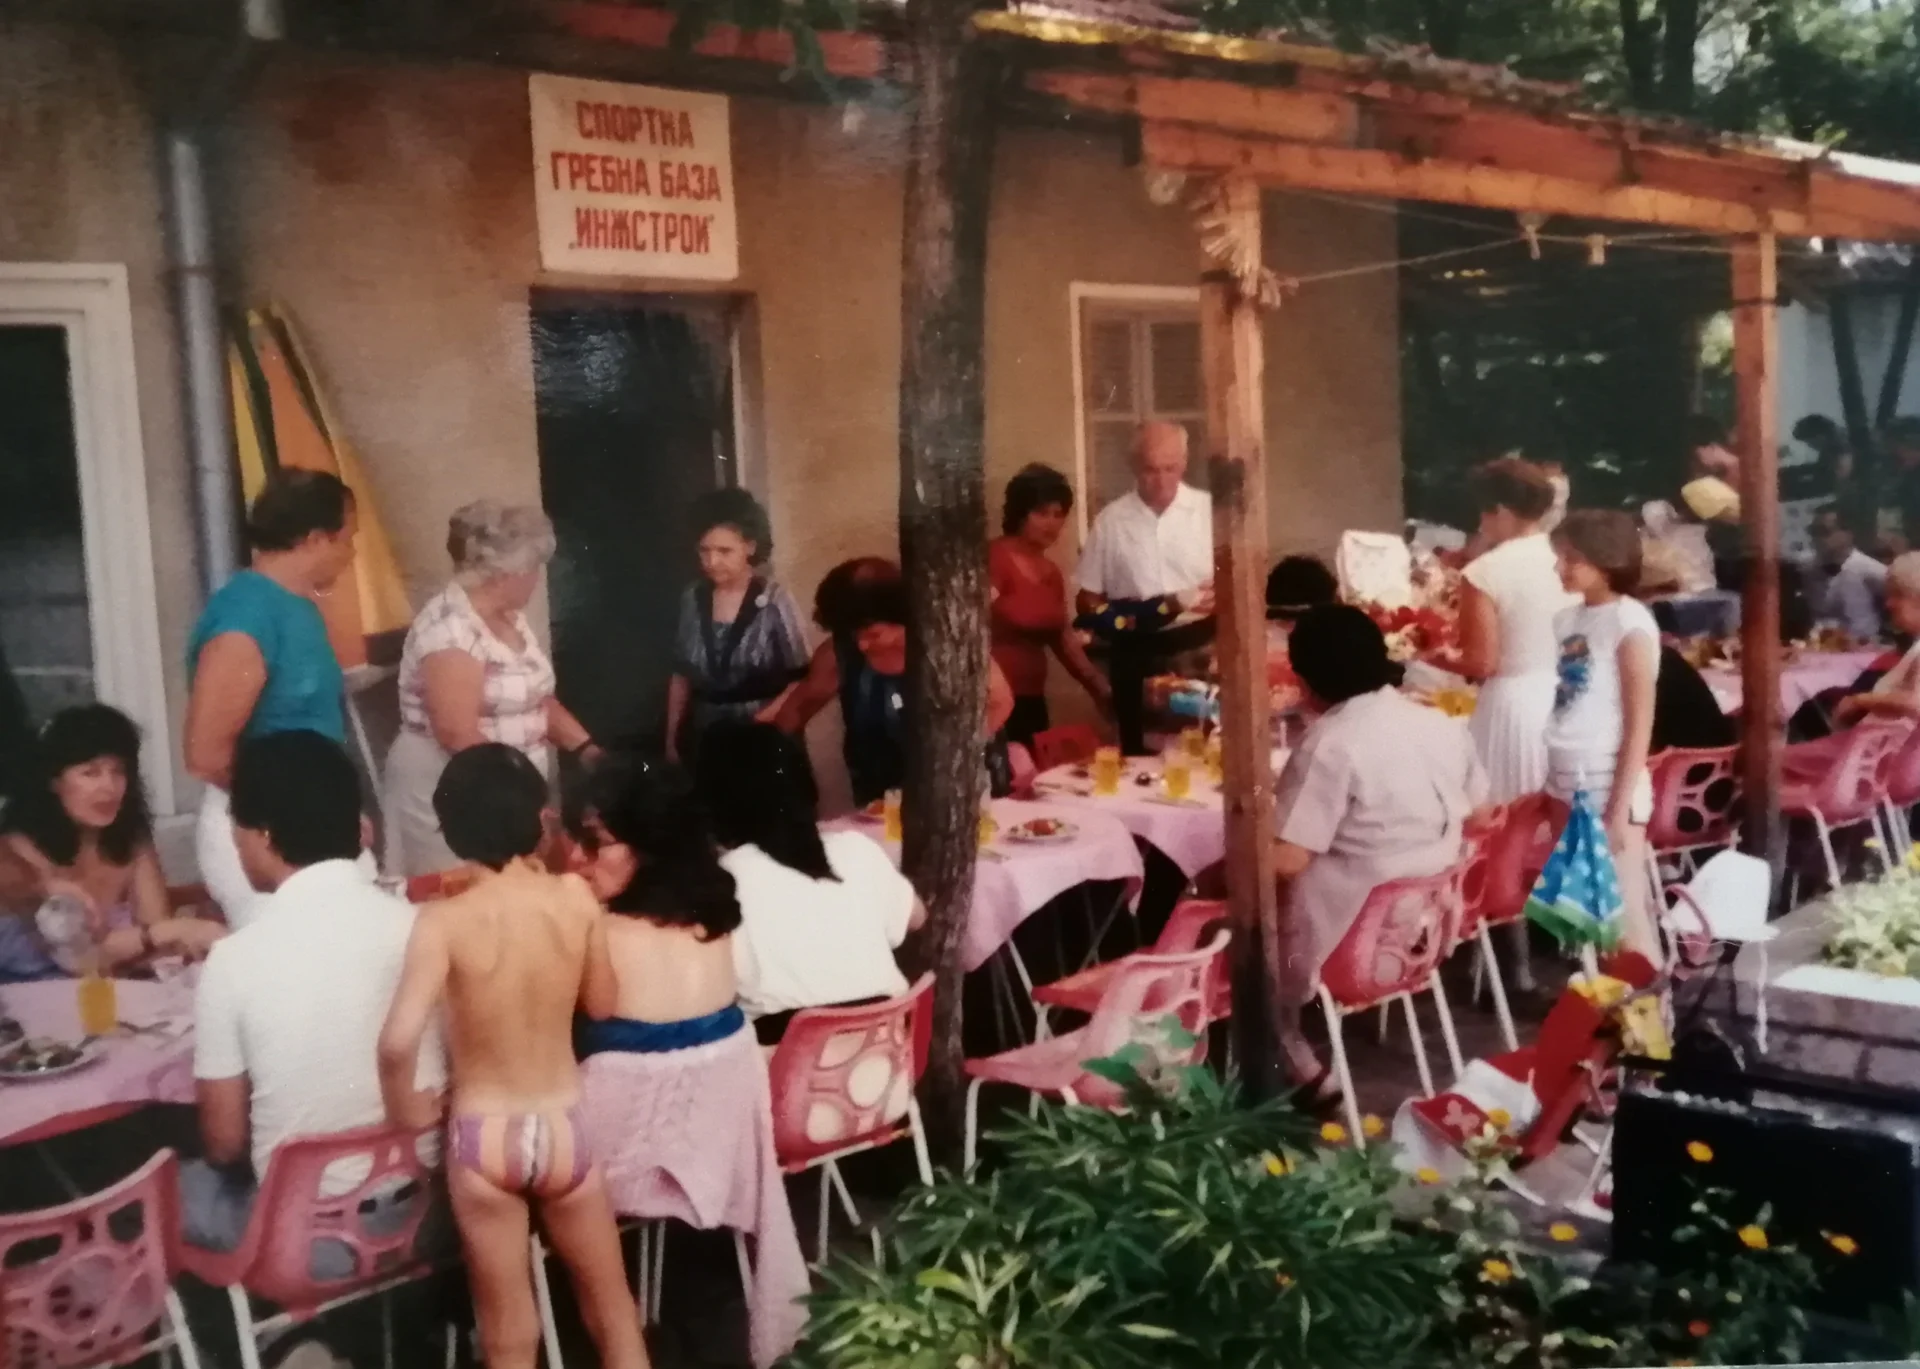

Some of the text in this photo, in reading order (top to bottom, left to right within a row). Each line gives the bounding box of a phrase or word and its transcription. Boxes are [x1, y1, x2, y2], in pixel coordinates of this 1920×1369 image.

[576, 101, 695, 149] СПОРТНА
[550, 151, 722, 202] ГРЕБНА БАЗА
